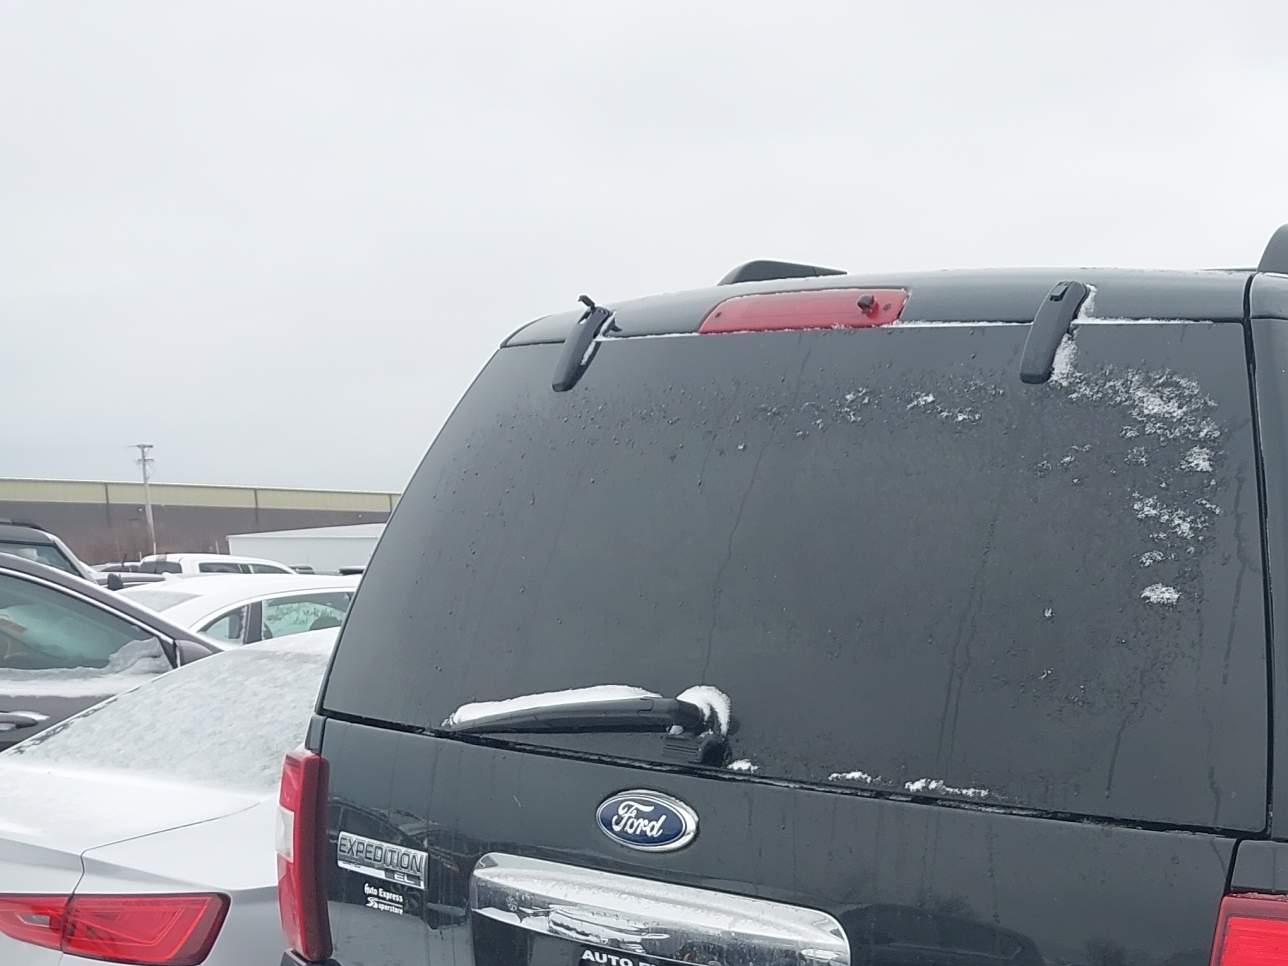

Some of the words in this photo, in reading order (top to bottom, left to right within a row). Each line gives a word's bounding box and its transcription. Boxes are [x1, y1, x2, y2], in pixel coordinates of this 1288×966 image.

[612, 800, 667, 837] Ford
[338, 837, 424, 874] EXPEDITION
[394, 872, 415, 884] EL
[378, 887, 403, 902] Express
